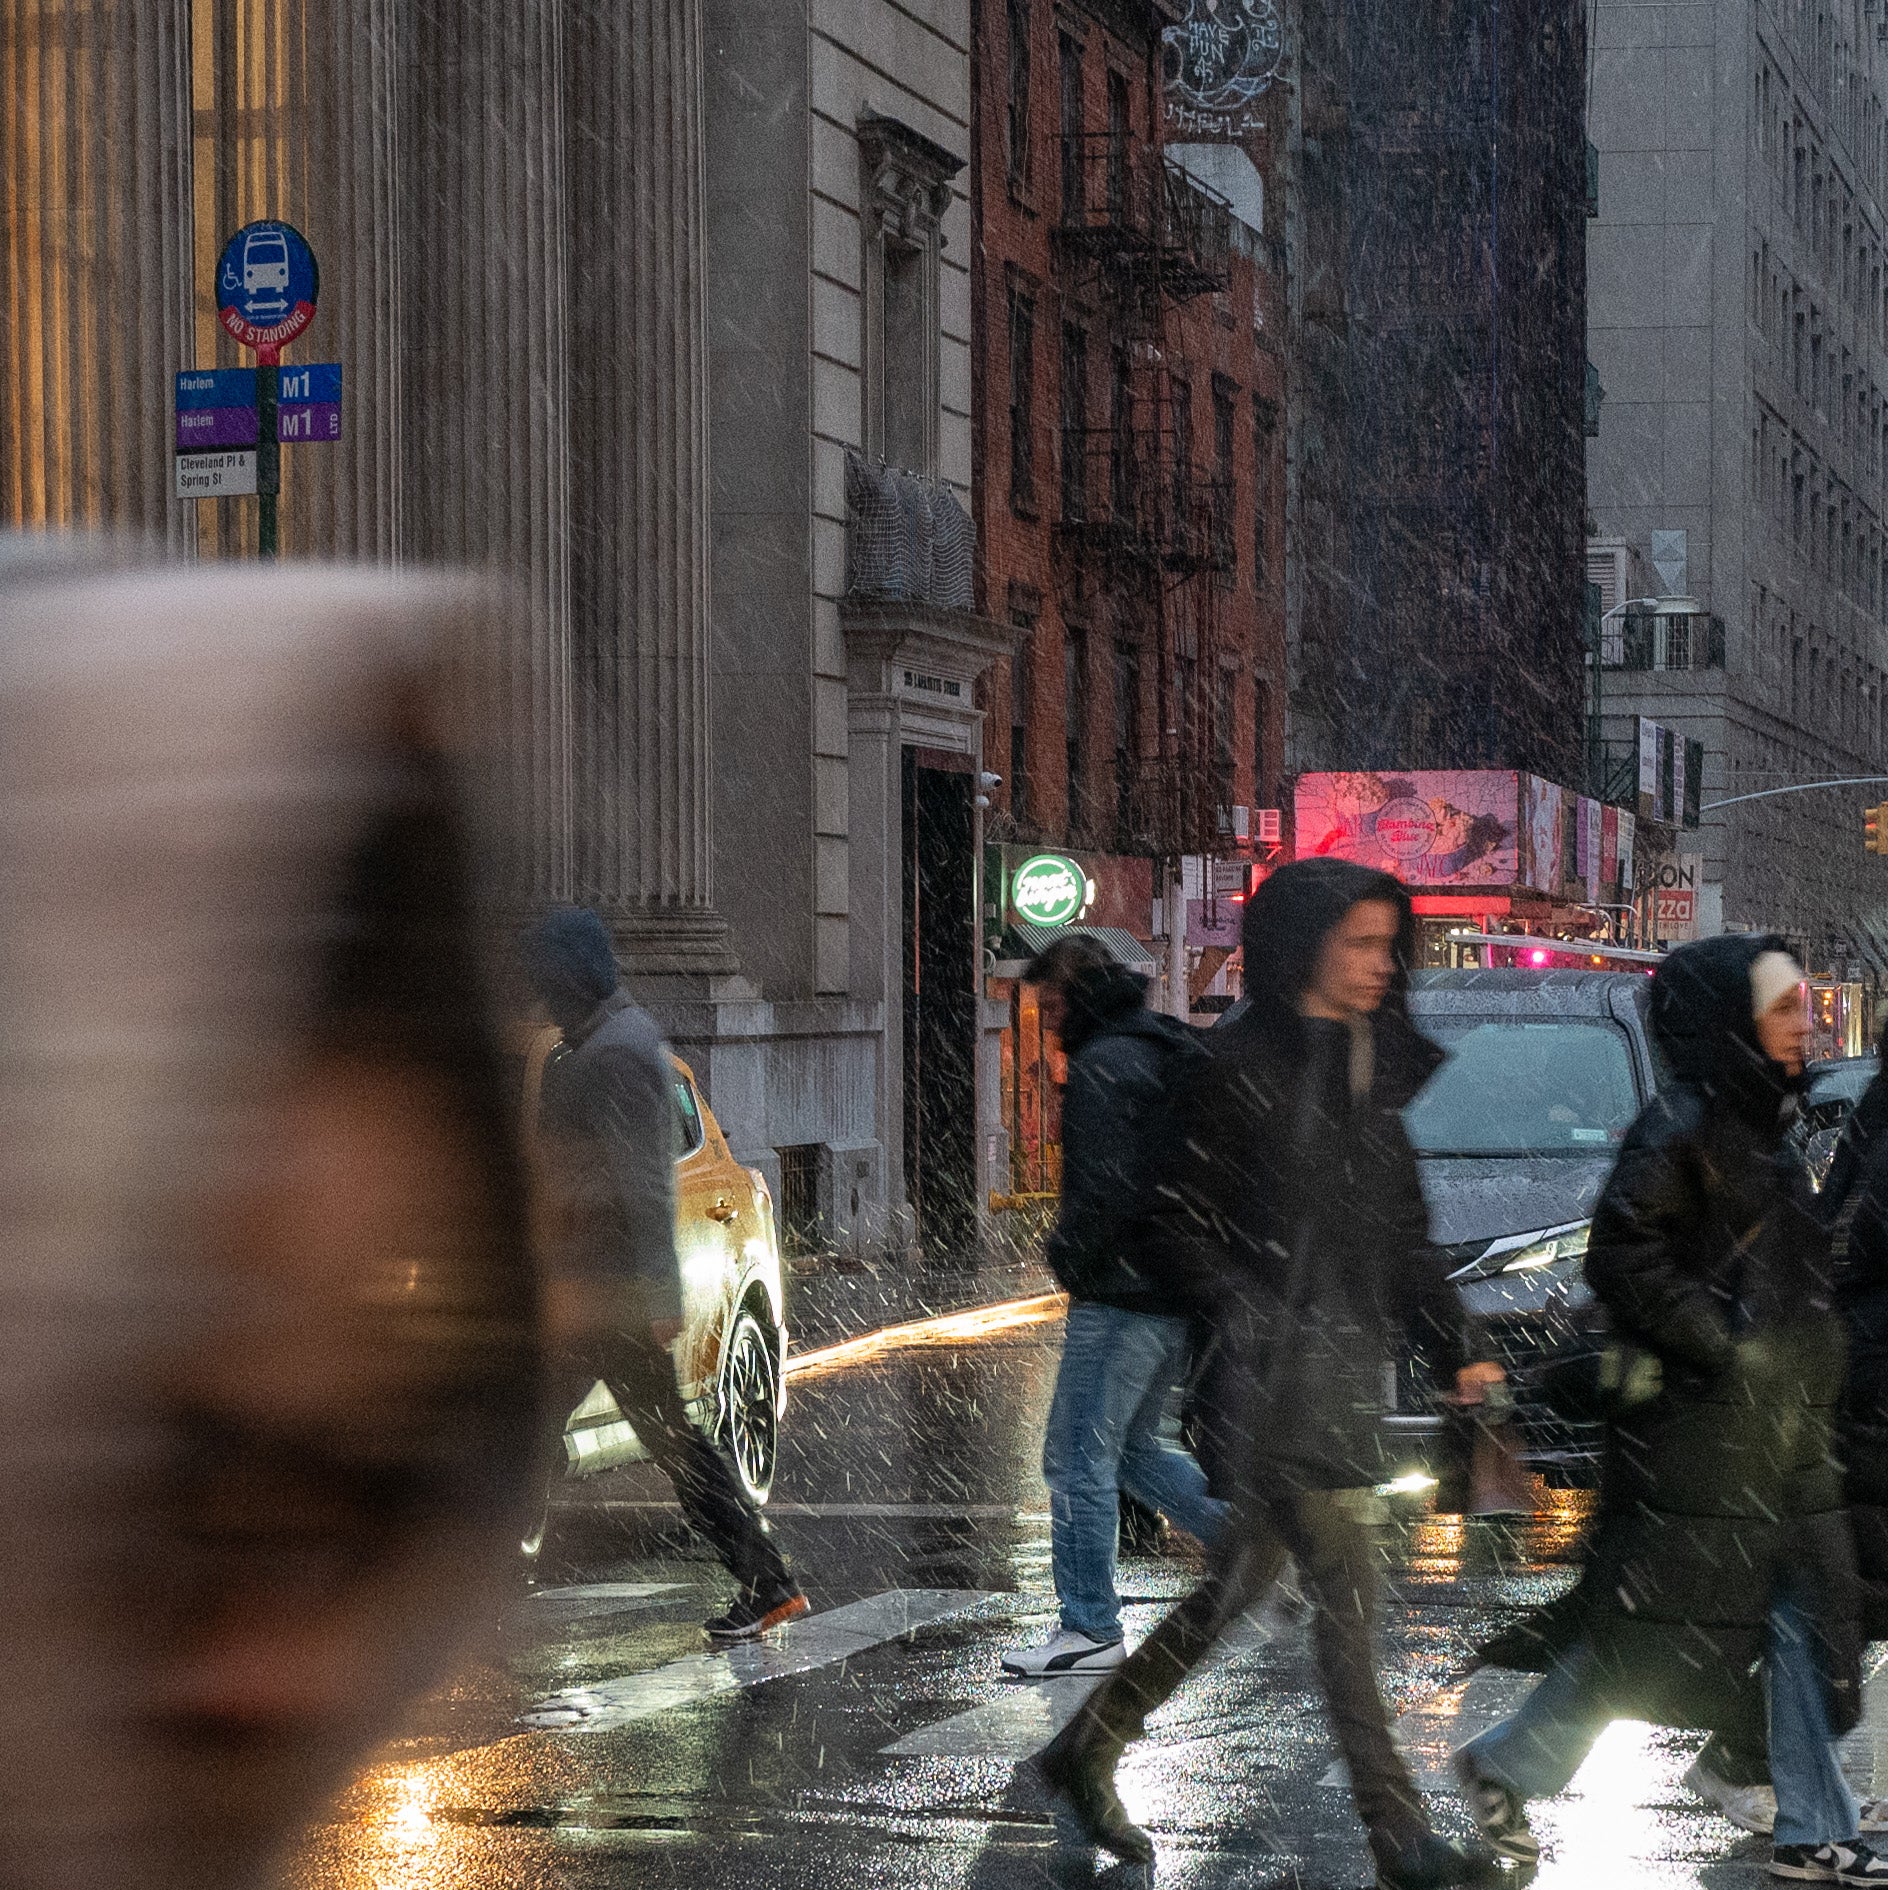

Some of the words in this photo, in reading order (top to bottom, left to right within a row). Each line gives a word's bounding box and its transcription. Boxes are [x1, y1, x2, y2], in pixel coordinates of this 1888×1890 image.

[1188, 21, 1229, 46] HAVE
[225, 311, 244, 335] NO
[246, 310, 307, 344] STANDING
[180, 376, 214, 390] Harlem
[282, 371, 310, 398] M1
[180, 414, 214, 428] Harlem
[282, 409, 312, 437] M1
[329, 413, 338, 435] LTD
[180, 455, 224, 471] Cleveland
[226, 455, 236, 469] Pl
[238, 455, 246, 468] &
[180, 473, 210, 488] Spring
[212, 472, 222, 486] St
[1660, 864, 1694, 888] ON
[1658, 900, 1690, 919] zza
